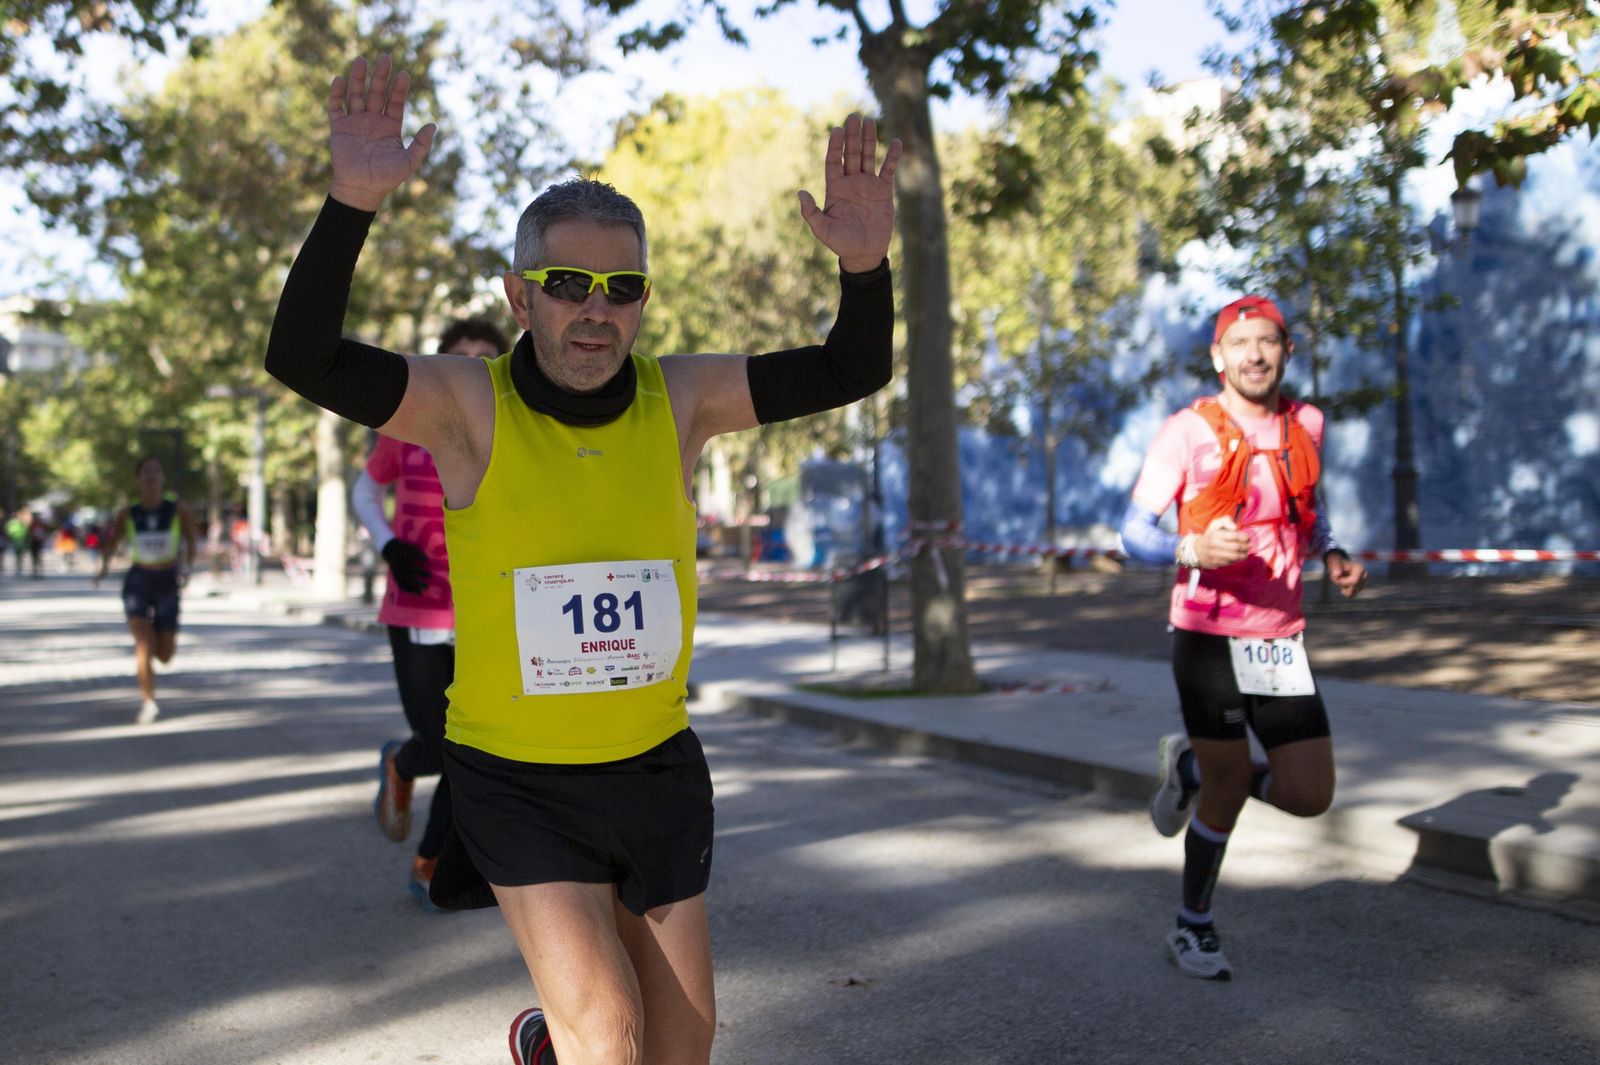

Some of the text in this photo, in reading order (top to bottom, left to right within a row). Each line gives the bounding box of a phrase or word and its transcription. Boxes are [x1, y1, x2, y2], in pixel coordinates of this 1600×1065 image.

[562, 590, 645, 635] 181
[581, 638, 636, 653] ENRIQUE
[1244, 644, 1293, 665] 1008
